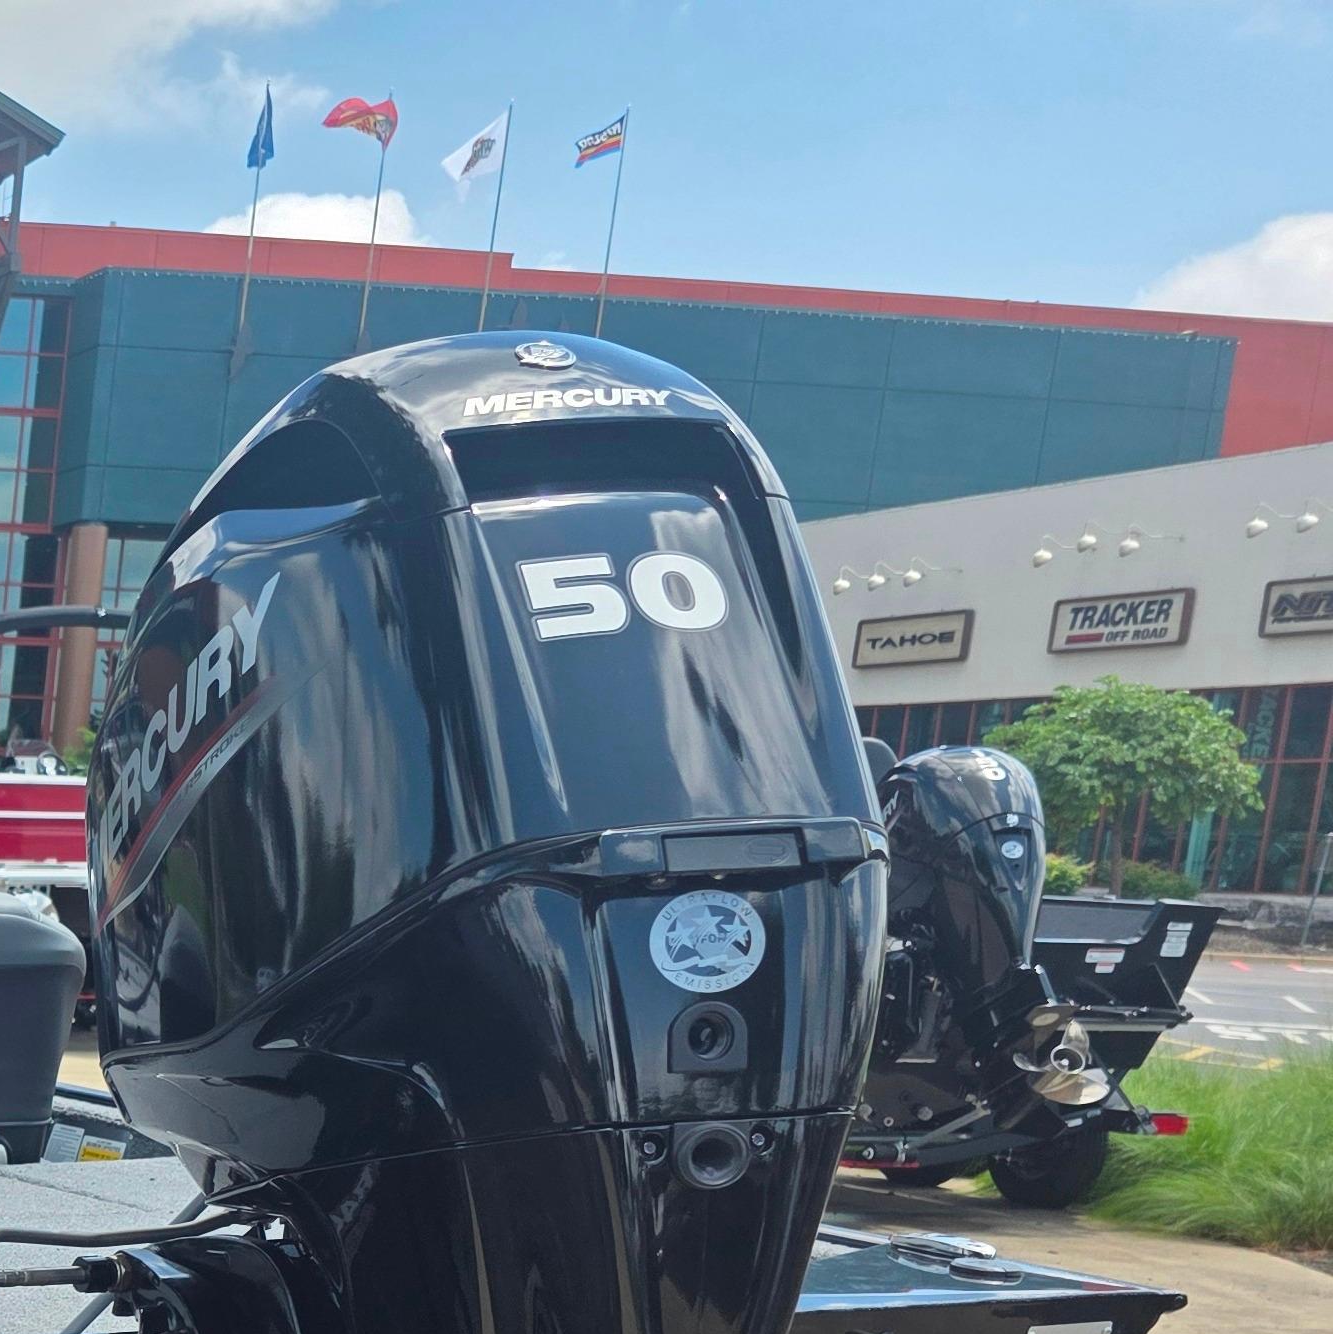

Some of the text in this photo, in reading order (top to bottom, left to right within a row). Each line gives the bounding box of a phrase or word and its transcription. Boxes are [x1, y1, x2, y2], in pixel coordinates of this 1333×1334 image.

[463, 388, 671, 417] MERCURY
[515, 550, 729, 642] 50
[1068, 598, 1174, 631] TRACKER
[866, 631, 956, 650] TAHOE
[1104, 627, 1169, 643] OFF ROAD
[95, 571, 281, 868] ERCURY
[720, 893, 754, 918] LOW
